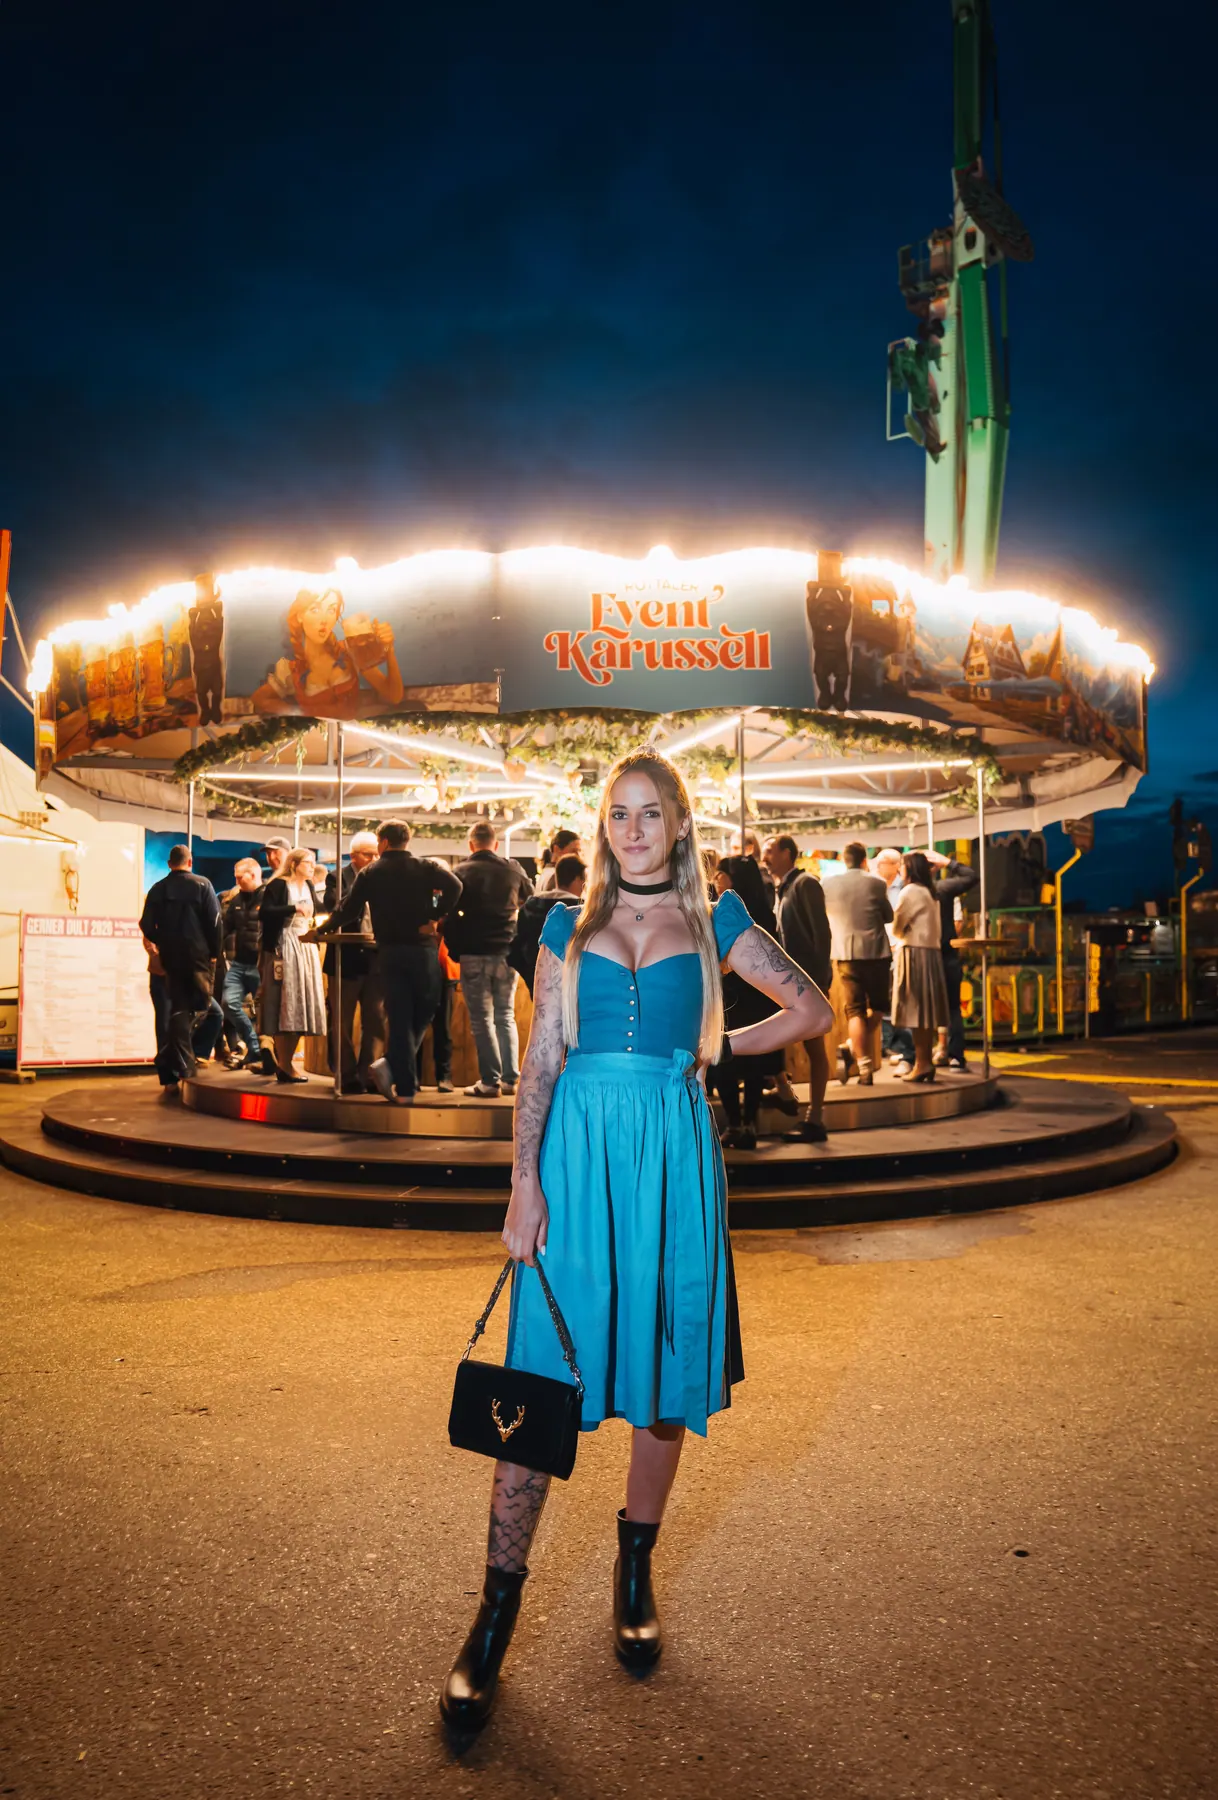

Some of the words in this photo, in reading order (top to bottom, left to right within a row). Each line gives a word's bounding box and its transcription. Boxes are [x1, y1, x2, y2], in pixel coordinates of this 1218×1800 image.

[590, 584, 724, 640] Event
[543, 622, 772, 687] Karussell
[66, 918, 88, 935] DULT
